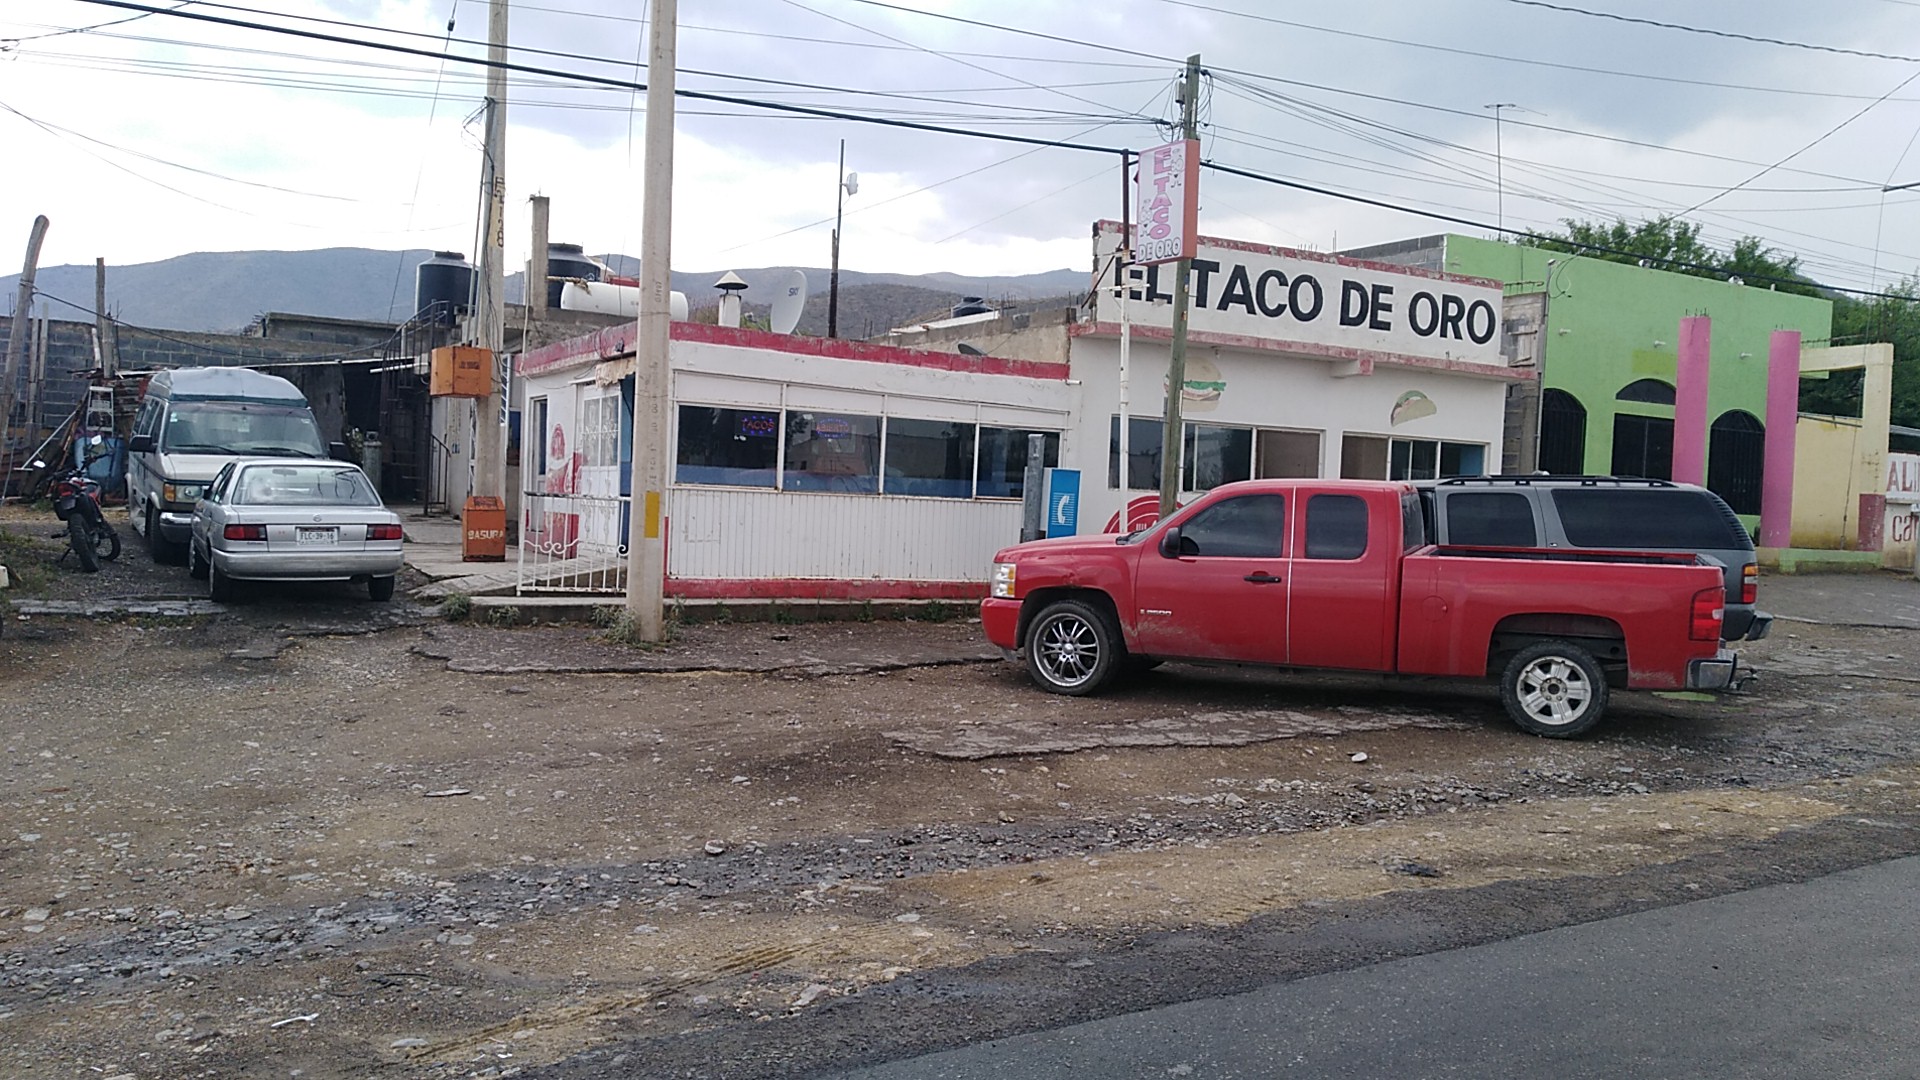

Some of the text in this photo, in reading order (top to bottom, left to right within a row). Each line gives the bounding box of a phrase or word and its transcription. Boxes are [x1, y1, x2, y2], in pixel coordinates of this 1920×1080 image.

[1149, 175, 1172, 240] TACO
[1138, 237, 1181, 262] DE ORO
[1190, 258, 1324, 322] TACO
[1339, 279, 1394, 331] DE
[1408, 291, 1496, 345] ORO
[742, 420, 775, 430] TACOS
[815, 423, 849, 432] ABIERTO
[467, 530, 504, 540] BASURA
